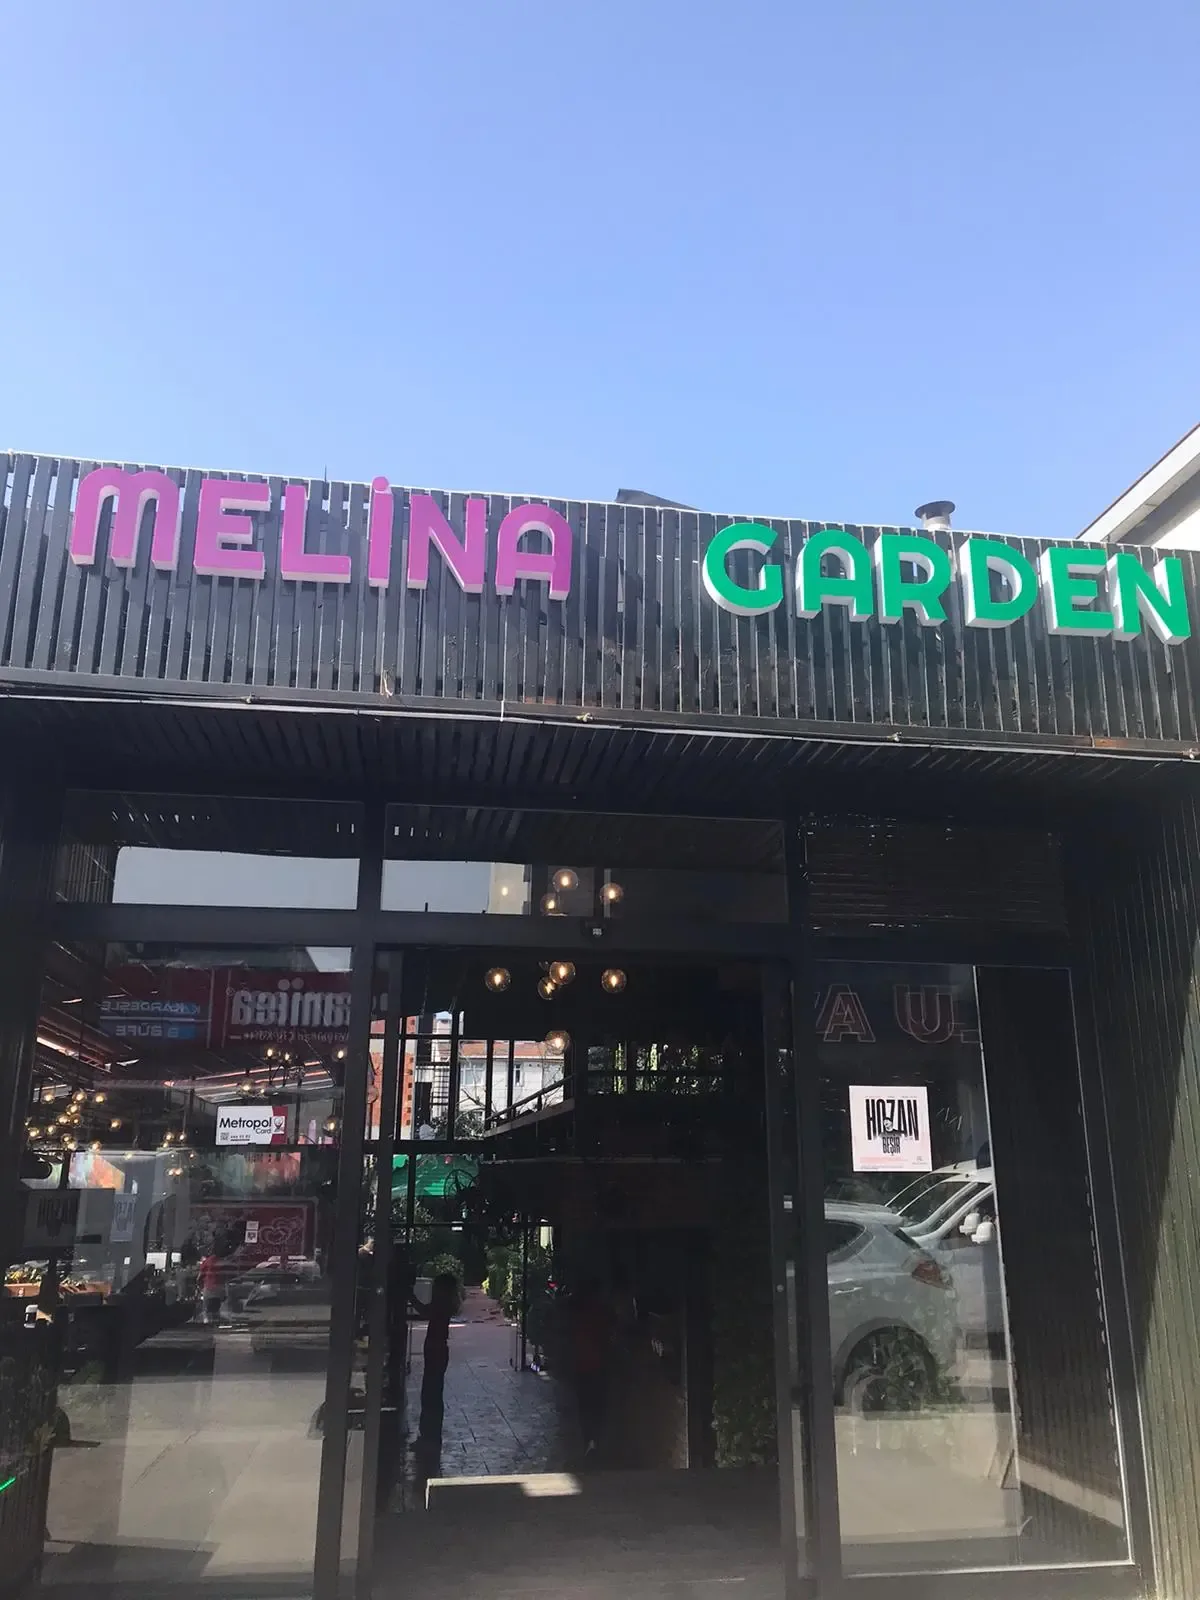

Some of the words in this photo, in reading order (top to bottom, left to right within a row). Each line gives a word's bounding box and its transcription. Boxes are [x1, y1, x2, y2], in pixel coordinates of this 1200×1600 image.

[702, 522, 1192, 645] GARDEN
[219, 1117, 272, 1129] Metropol
[865, 1099, 919, 1141] HOZAN
